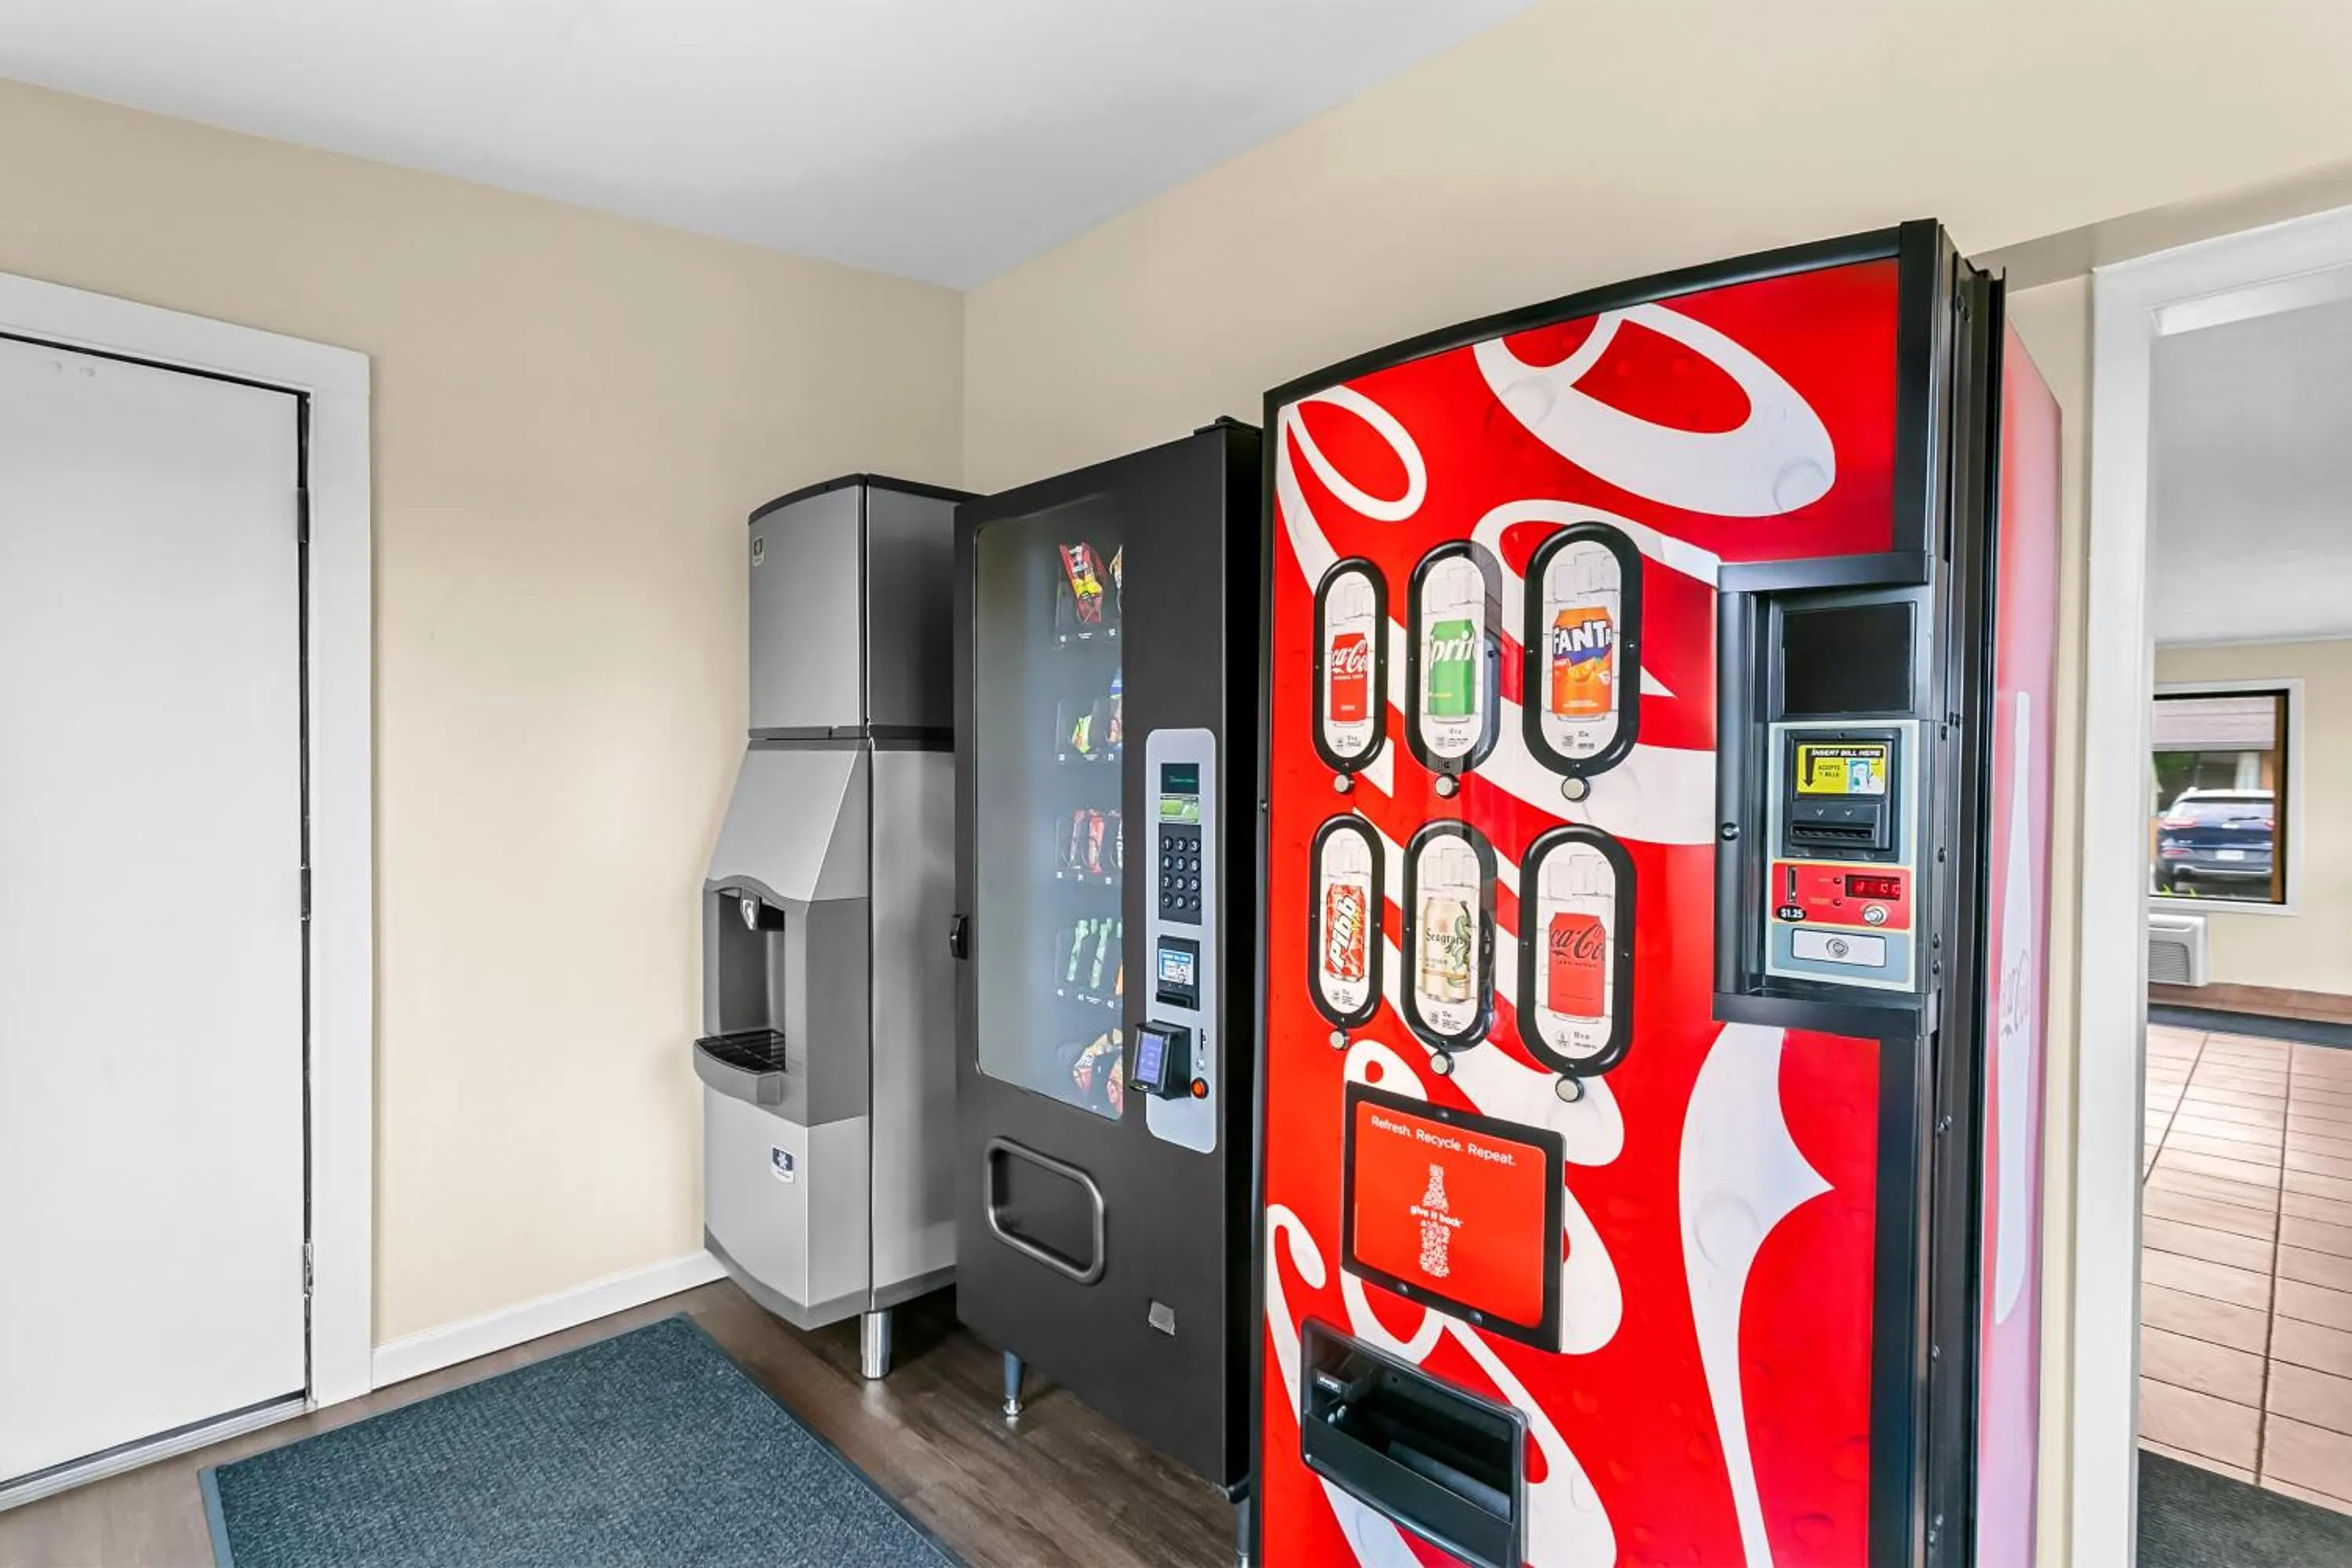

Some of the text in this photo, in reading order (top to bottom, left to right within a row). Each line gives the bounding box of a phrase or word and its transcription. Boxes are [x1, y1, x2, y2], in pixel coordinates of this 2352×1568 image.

[1780, 908, 1804, 916] $1.25
[1371, 1116, 1517, 1166] Refresh. Recycle. Repeat.
[1410, 1204, 1462, 1229] give it back
